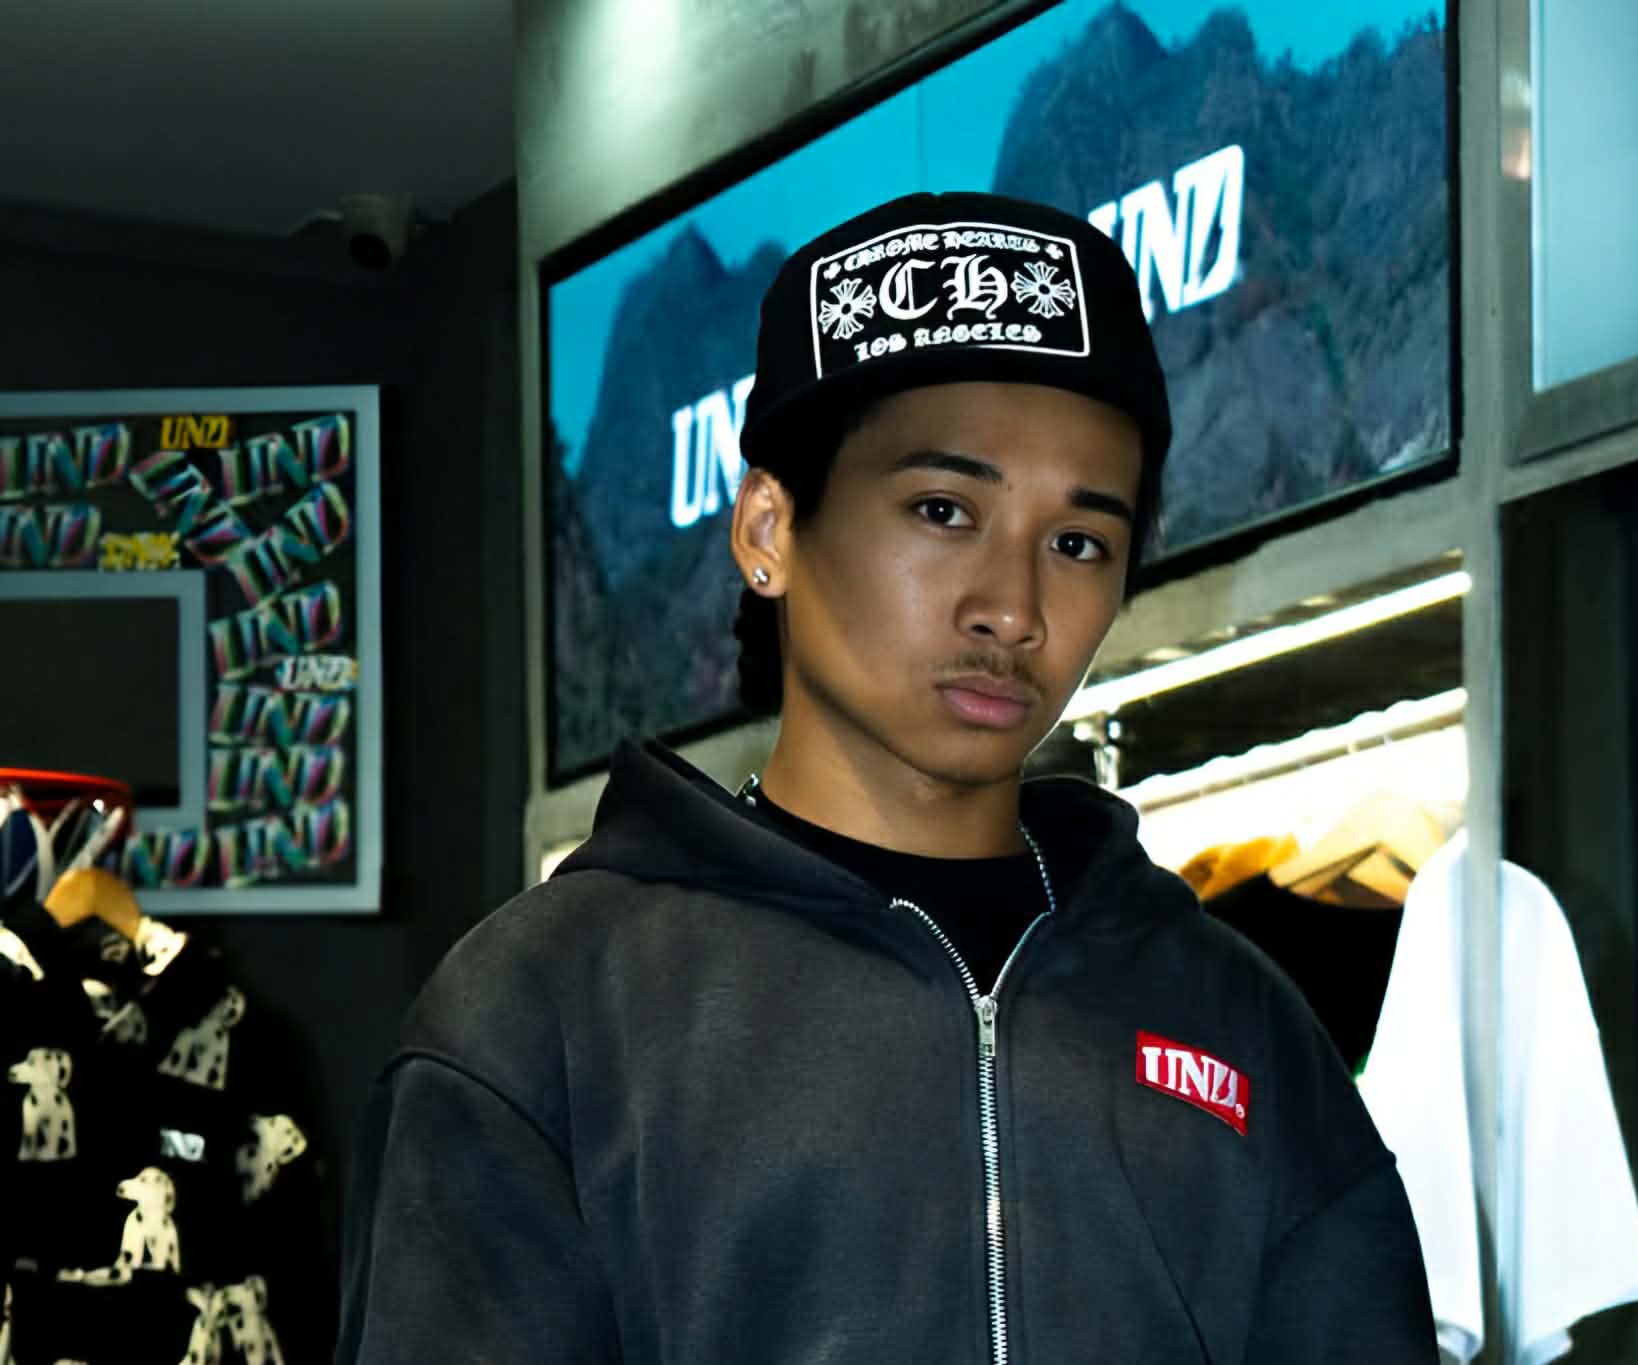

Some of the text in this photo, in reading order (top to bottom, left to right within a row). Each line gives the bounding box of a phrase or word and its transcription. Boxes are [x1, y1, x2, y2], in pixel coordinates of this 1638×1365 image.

[844, 232, 941, 272] CHROME
[878, 254, 1009, 320] CH
[854, 322, 1042, 362] LOS ANGELES
